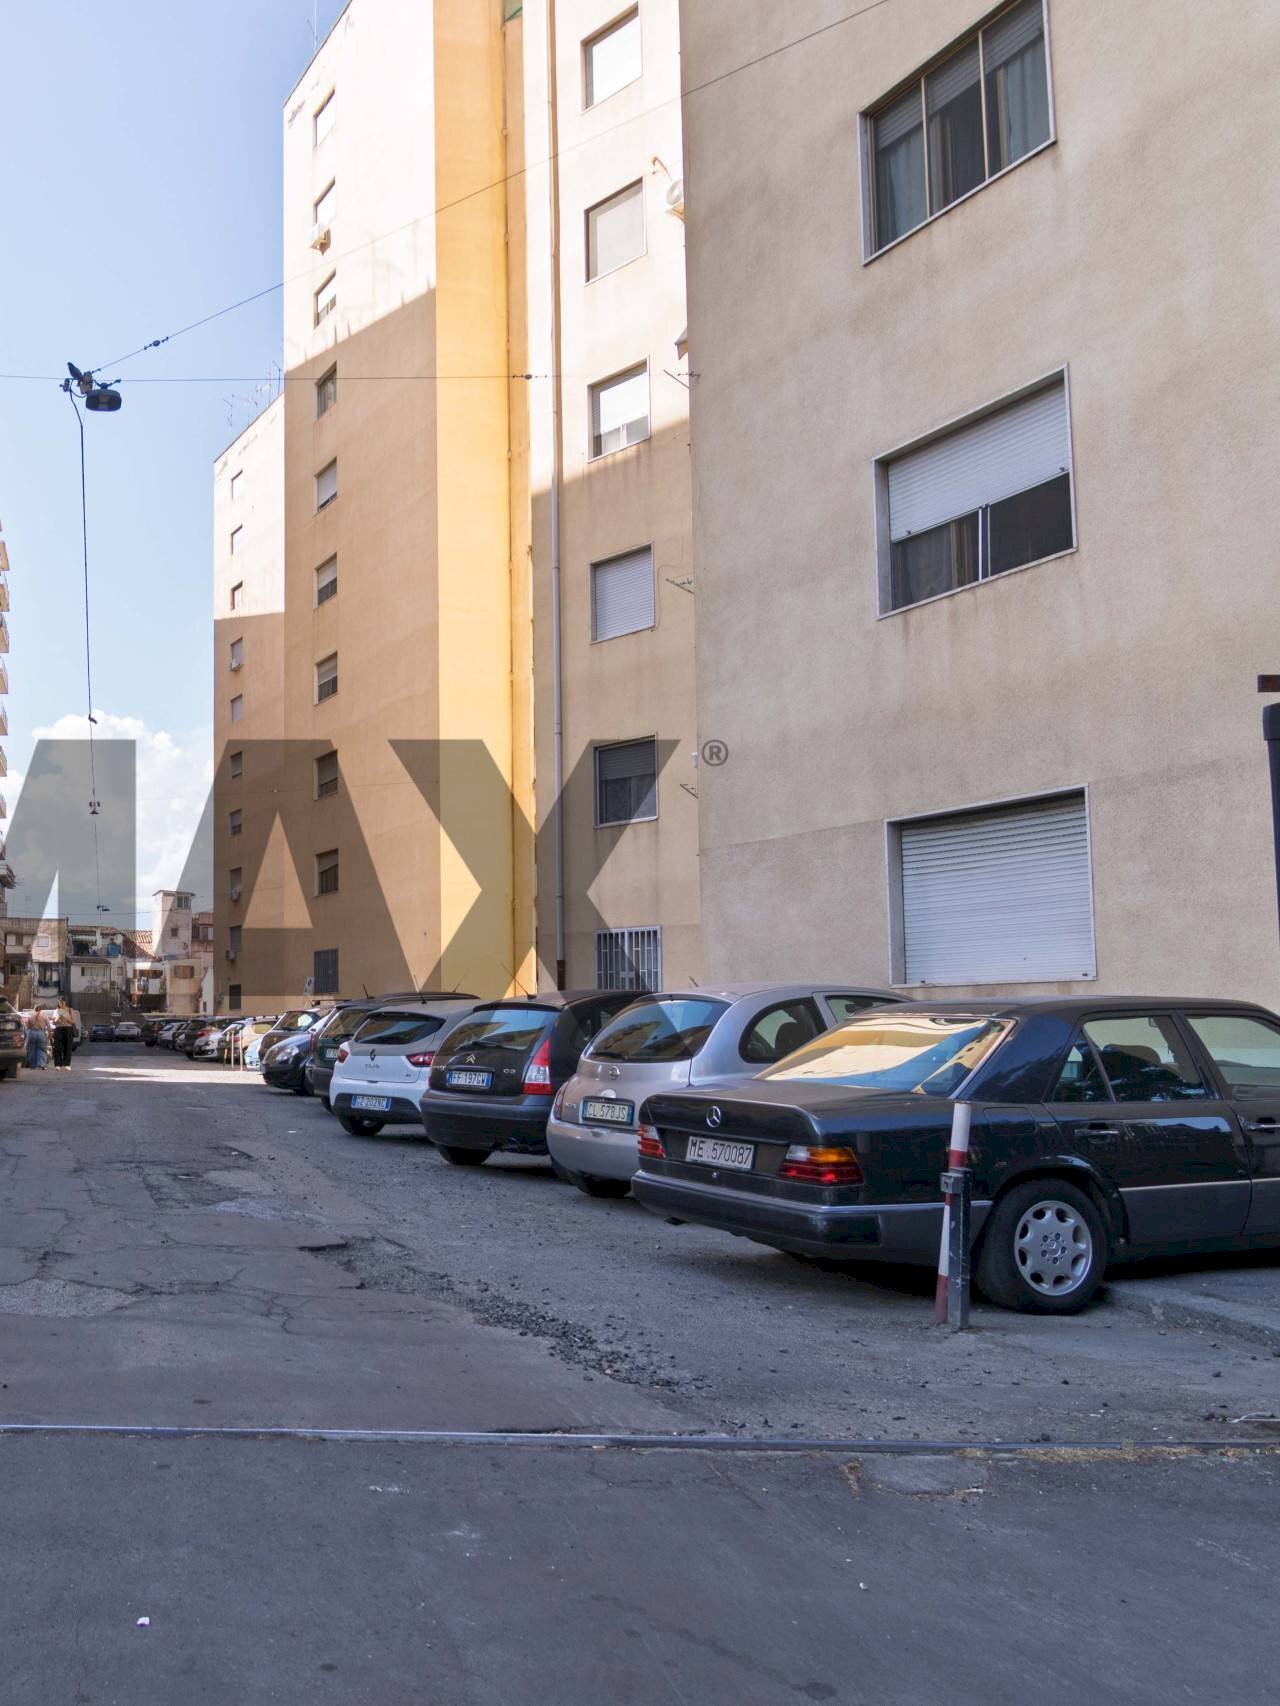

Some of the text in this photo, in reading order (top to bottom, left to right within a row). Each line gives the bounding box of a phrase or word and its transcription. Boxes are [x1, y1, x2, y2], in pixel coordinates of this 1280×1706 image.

[600, 1105, 626, 1120] 578JS
[690, 1139, 752, 1165] ME 570087
